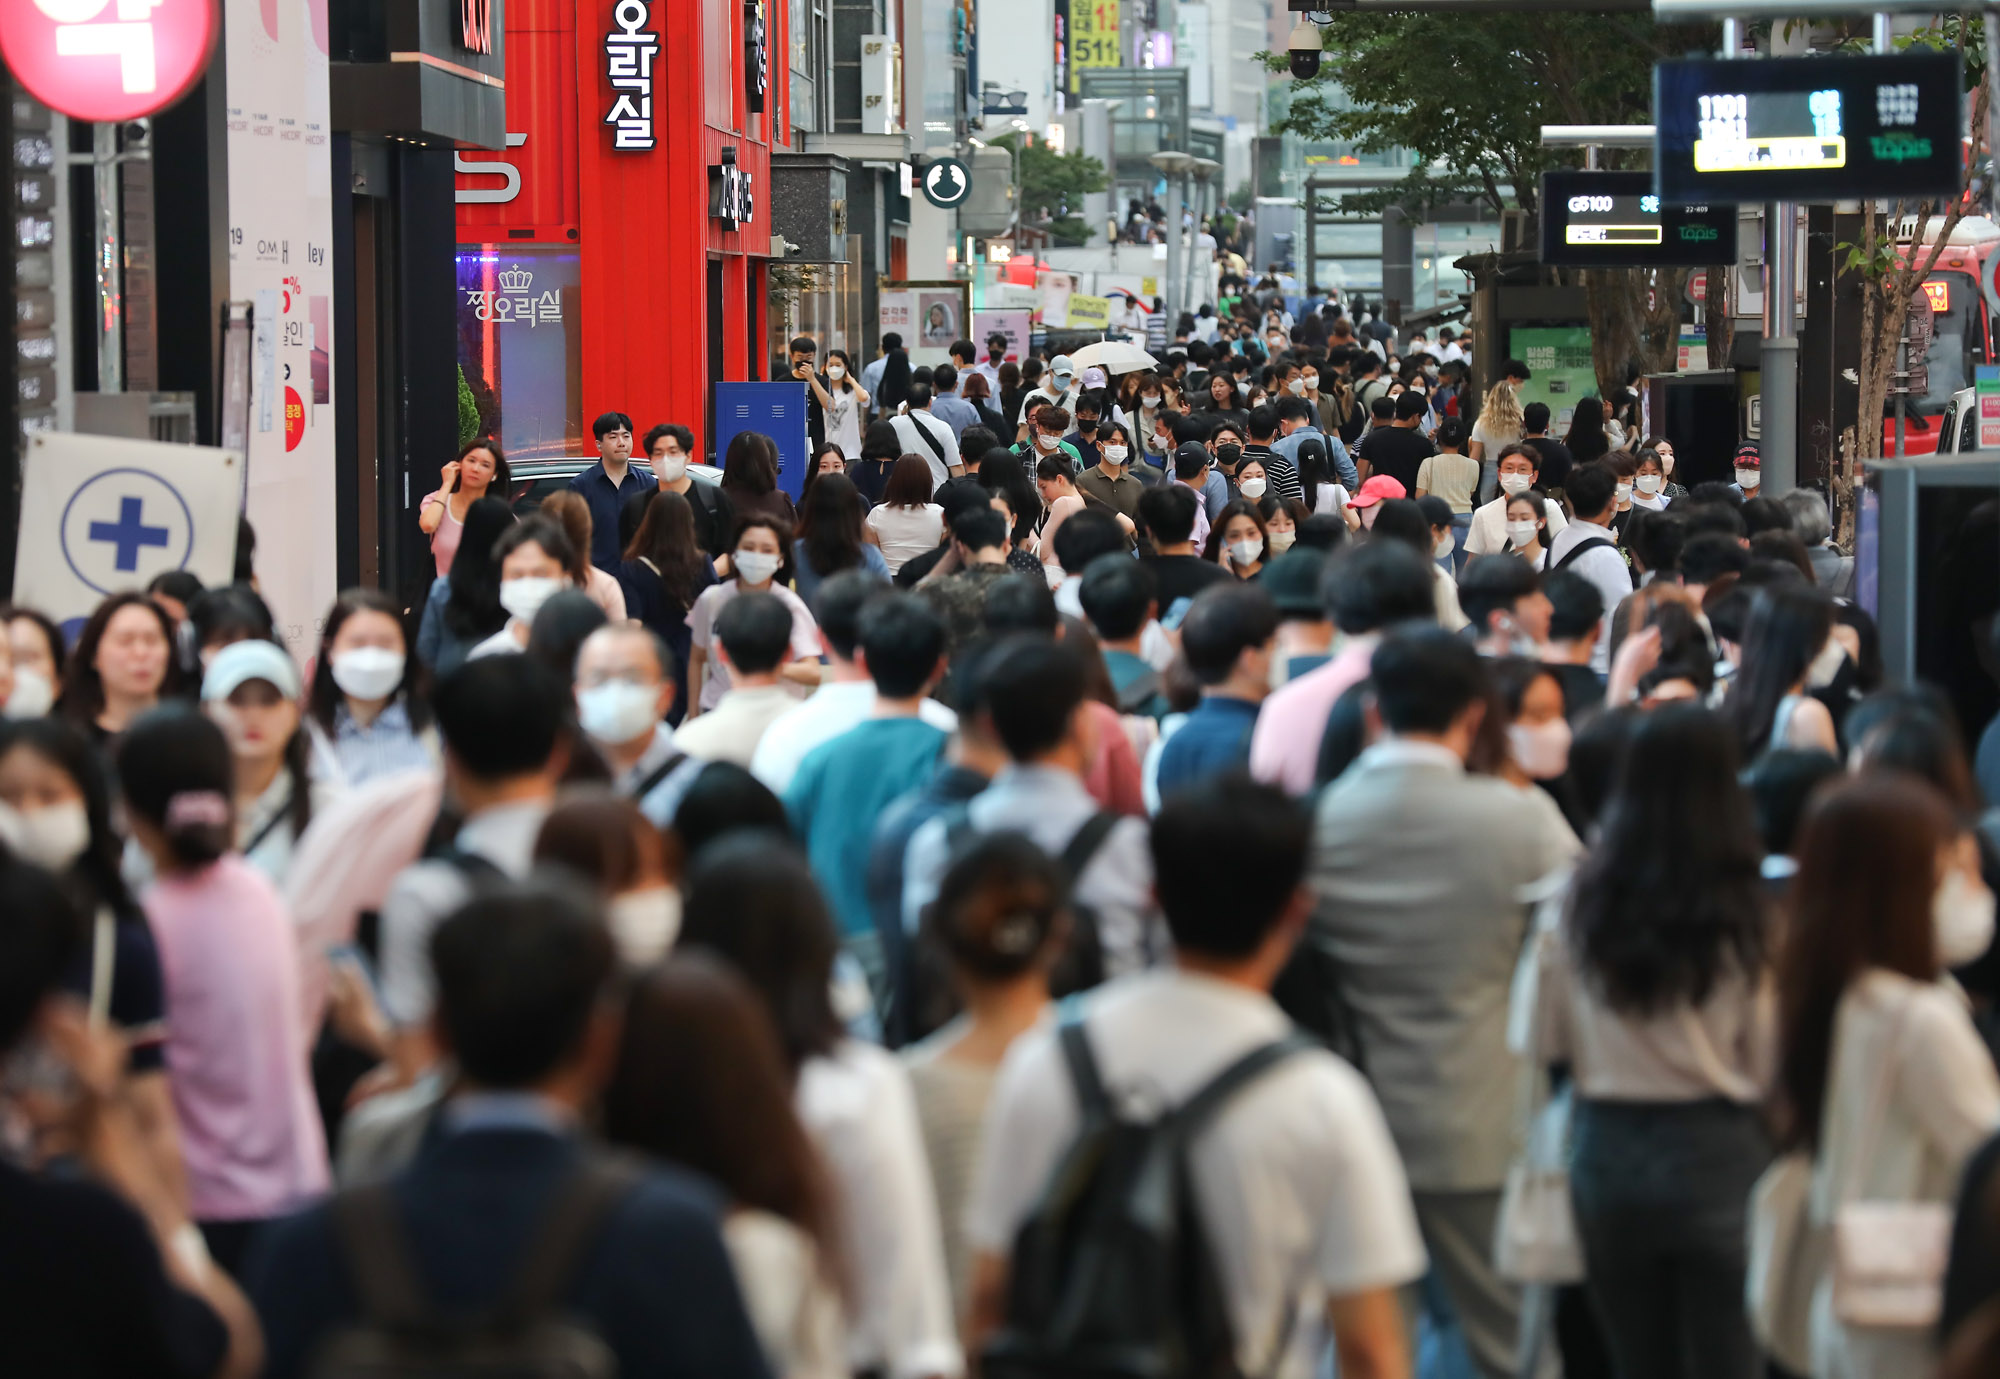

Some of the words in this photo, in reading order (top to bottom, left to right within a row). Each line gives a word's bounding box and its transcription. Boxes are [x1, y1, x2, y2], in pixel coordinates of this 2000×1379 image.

[606, 0, 658, 148] 오락실
[865, 95, 882, 108] 5F
[1699, 94, 1747, 120] 1101
